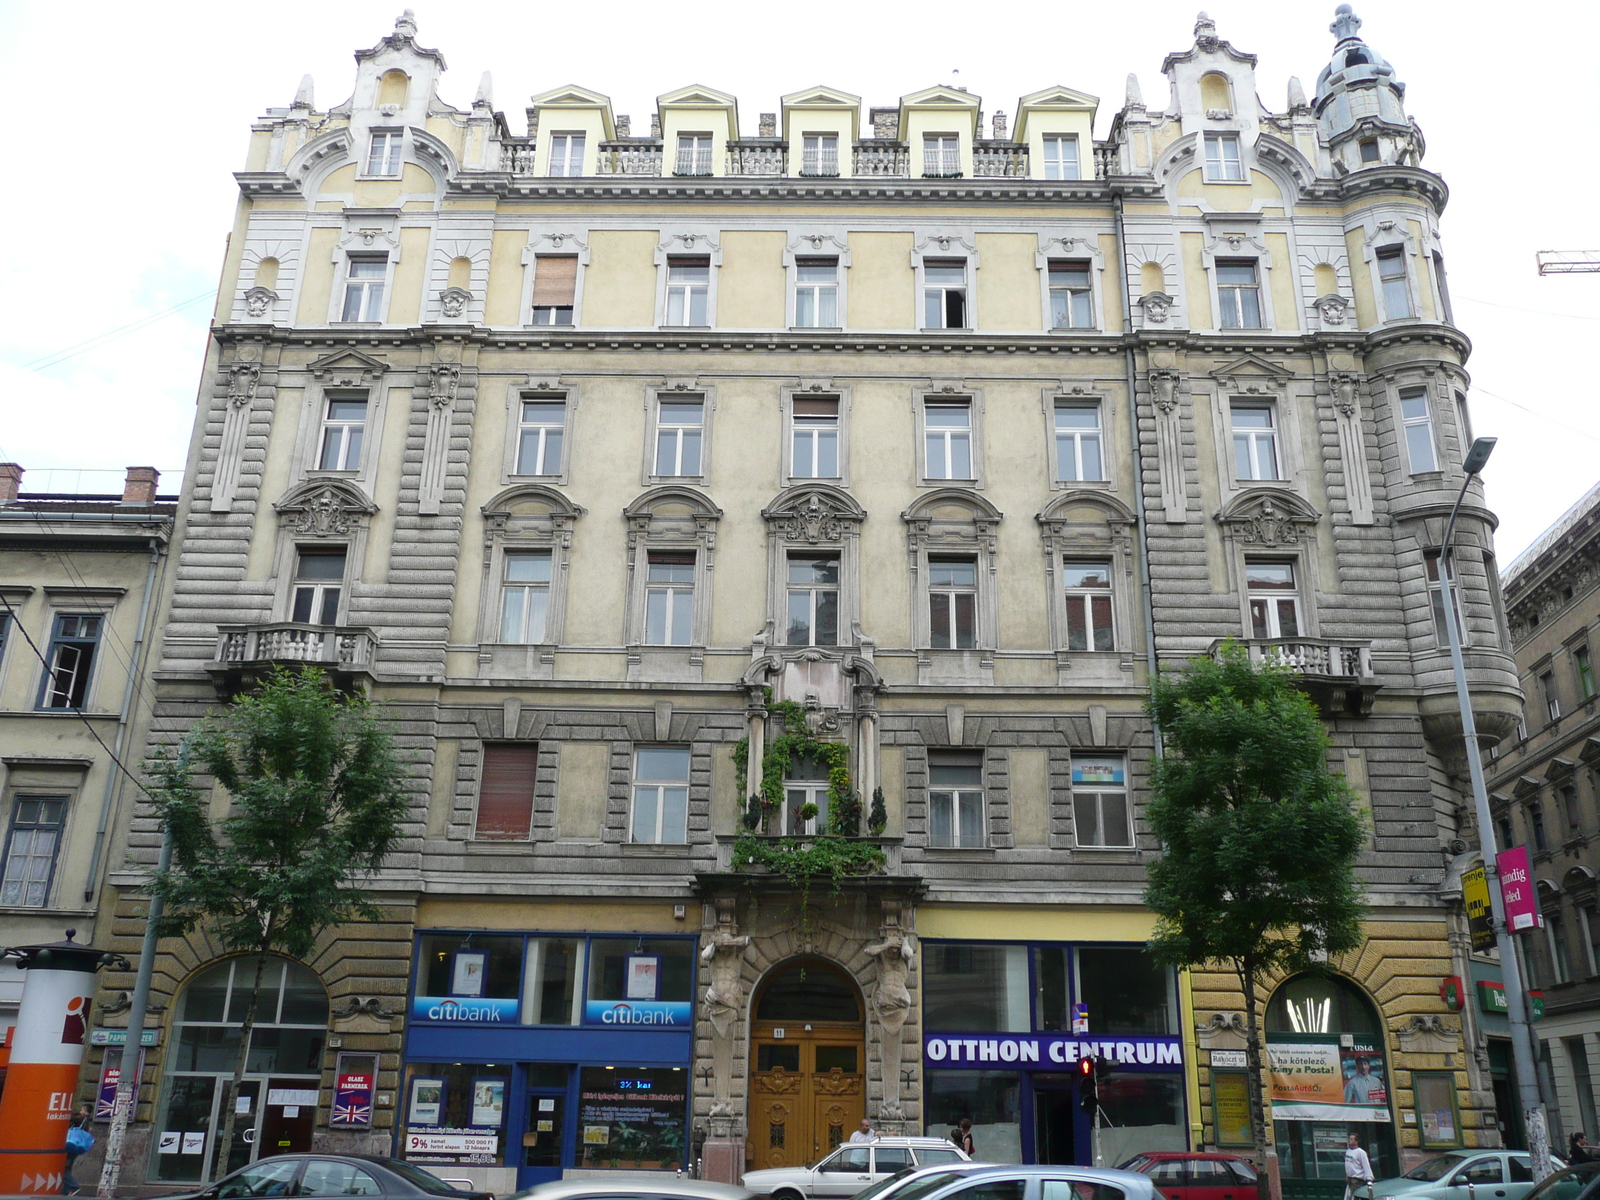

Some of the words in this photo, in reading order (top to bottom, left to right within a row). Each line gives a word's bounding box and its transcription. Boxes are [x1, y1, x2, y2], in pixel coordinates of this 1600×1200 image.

[428, 1001, 501, 1022] citibank
[602, 1004, 675, 1025] citibank
[927, 1038, 1039, 1062] OTTHON
[1049, 1040, 1182, 1064] CENTRUM
[1304, 1066, 1335, 1075] Posta!
[411, 1137, 428, 1149] 9%
